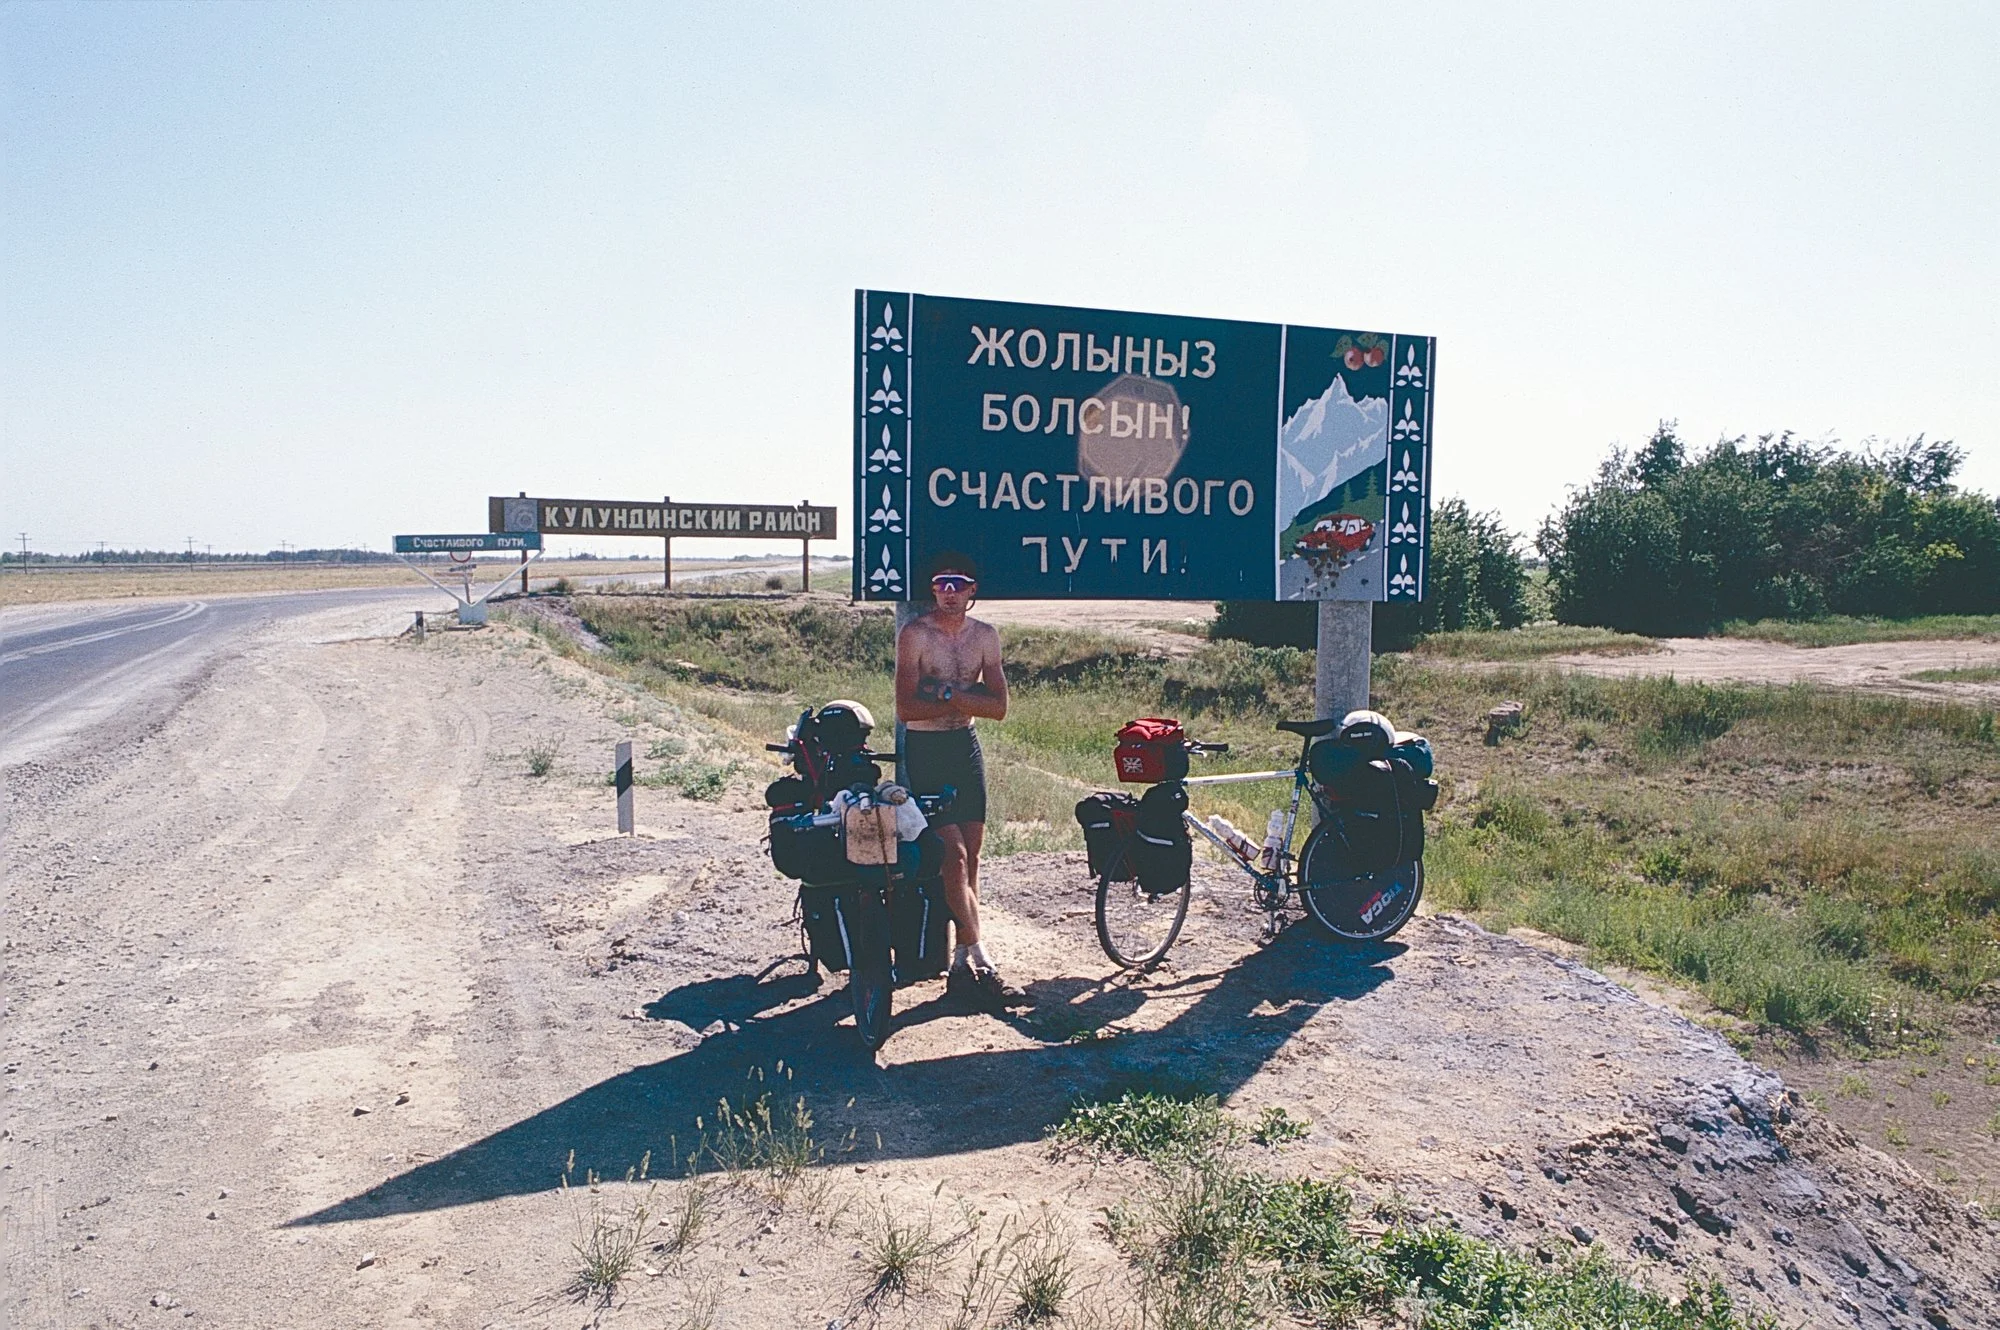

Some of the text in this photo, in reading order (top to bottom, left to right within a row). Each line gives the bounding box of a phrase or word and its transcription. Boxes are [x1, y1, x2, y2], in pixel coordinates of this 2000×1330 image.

[982, 393, 1190, 440] БОЛСЫН!
[928, 467, 1255, 516] СЧАСТЛИВОГО
[1022, 536, 1187, 574] ПУТИ
